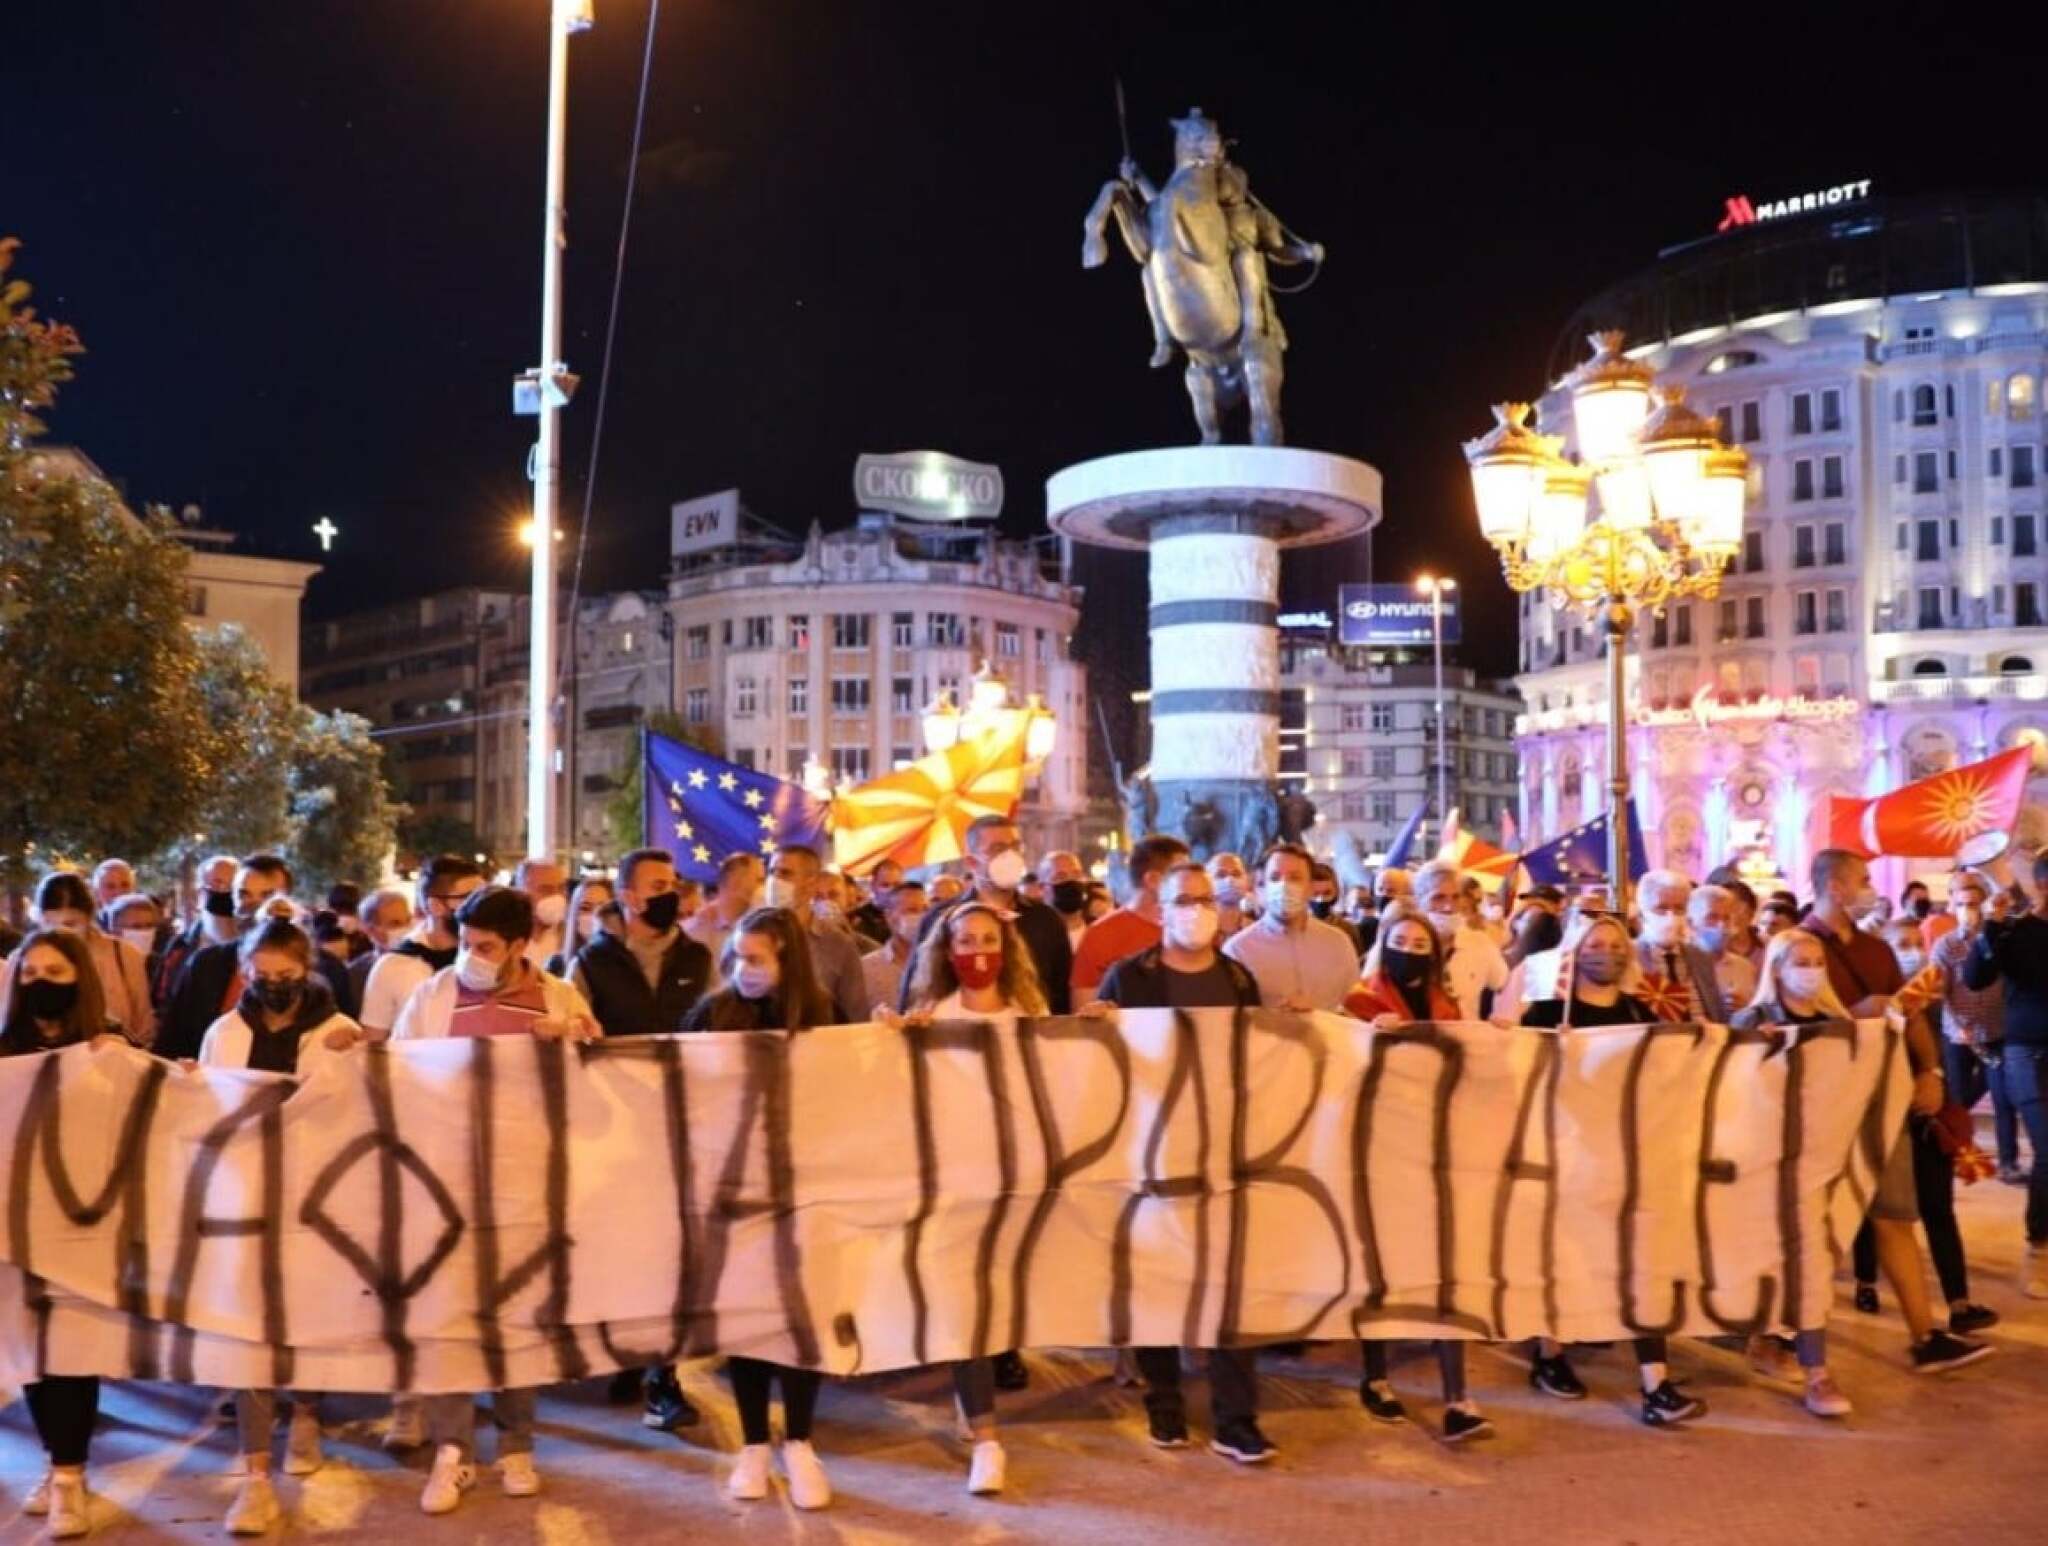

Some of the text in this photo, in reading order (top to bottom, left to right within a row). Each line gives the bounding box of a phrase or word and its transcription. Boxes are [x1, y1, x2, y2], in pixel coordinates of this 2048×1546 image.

[1756, 179, 1871, 222] MARRIOTT
[684, 508, 720, 538] EVN
[904, 1007, 1562, 1363] ПРАВДА
